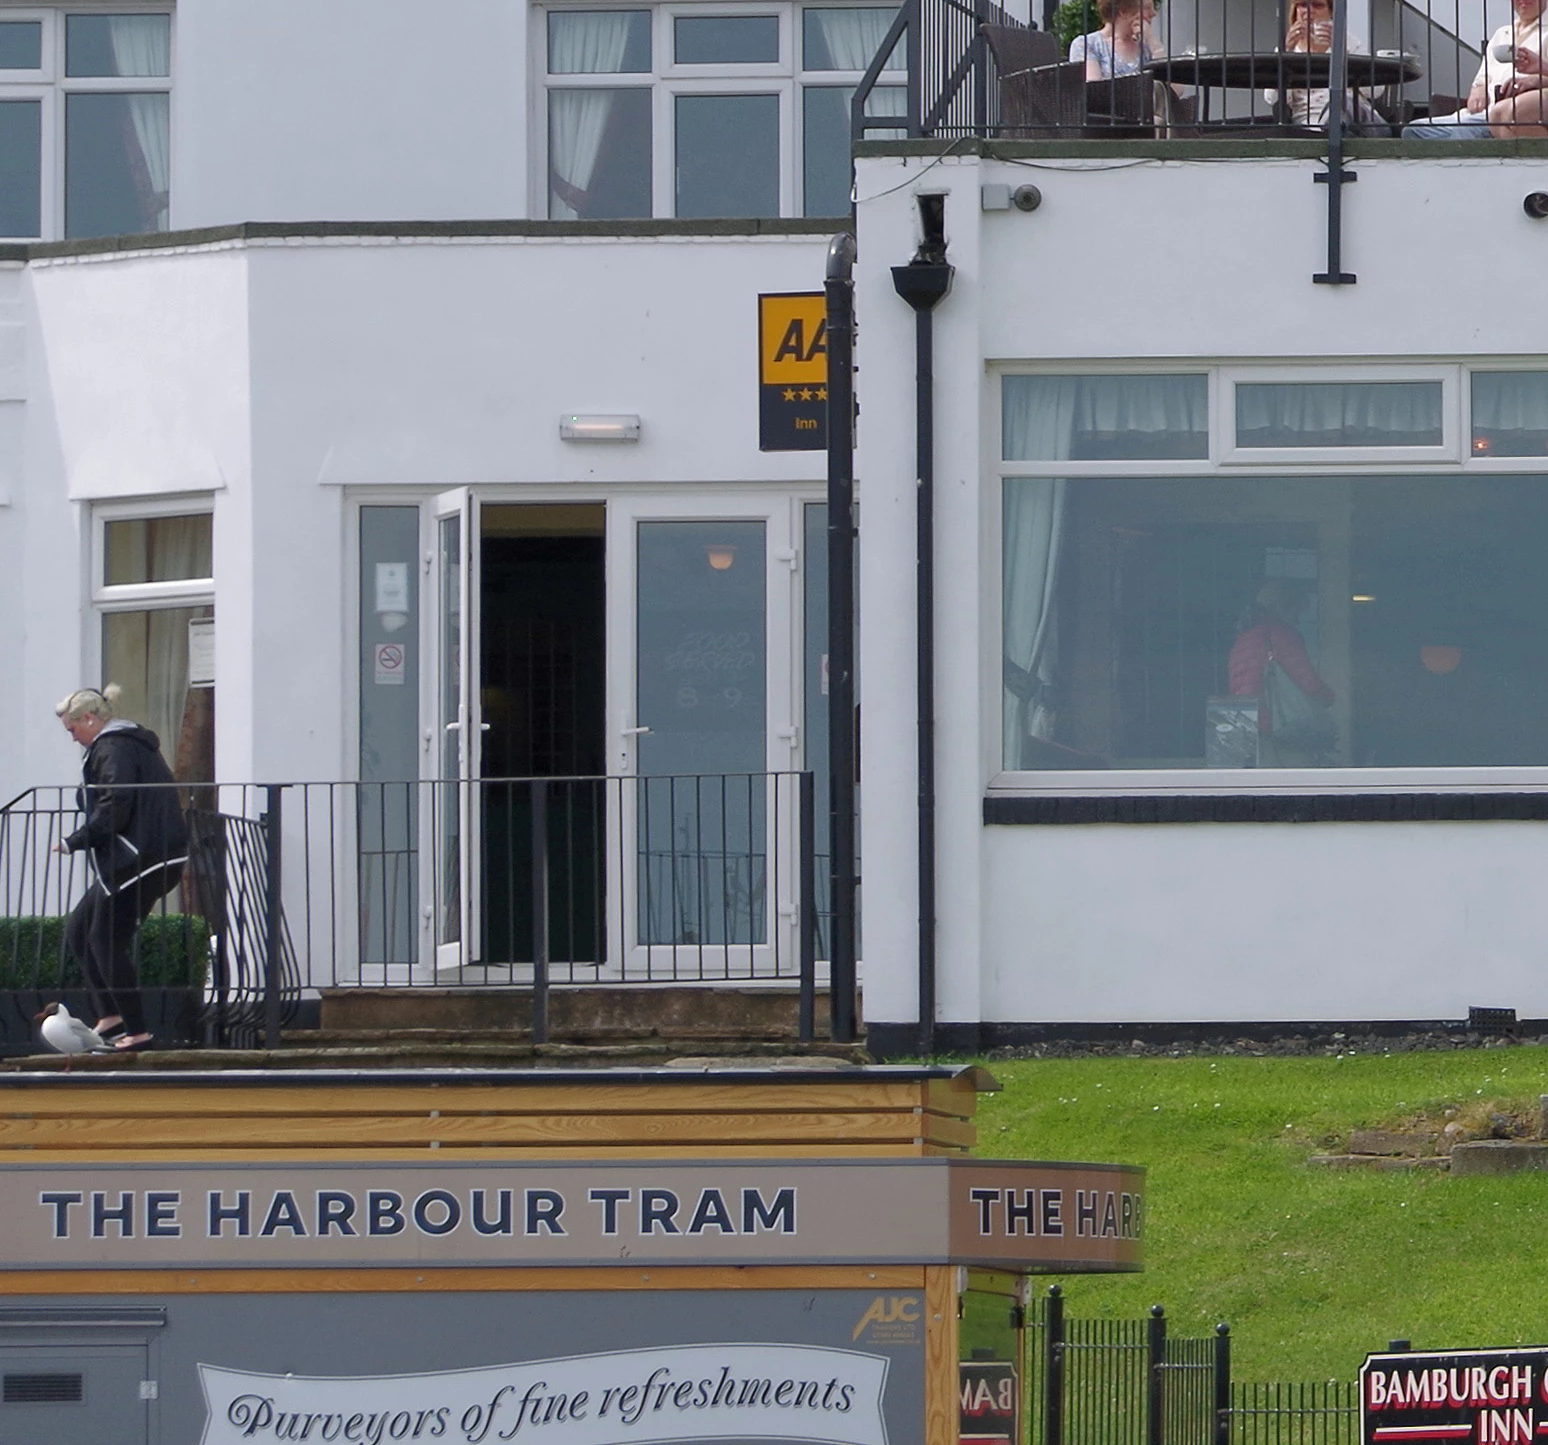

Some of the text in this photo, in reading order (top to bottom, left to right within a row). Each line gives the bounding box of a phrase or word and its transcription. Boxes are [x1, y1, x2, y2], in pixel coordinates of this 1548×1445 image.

[774, 318, 828, 362] AA
[795, 417, 818, 430] Inn
[39, 1186, 798, 1239] THE HARBOUR TRAM
[969, 1187, 1065, 1237] THE
[226, 1365, 857, 1445] Purveyors of fine refreshments
[1369, 1365, 1533, 1405] BAMBURGH
[1480, 1408, 1534, 1444] INN
